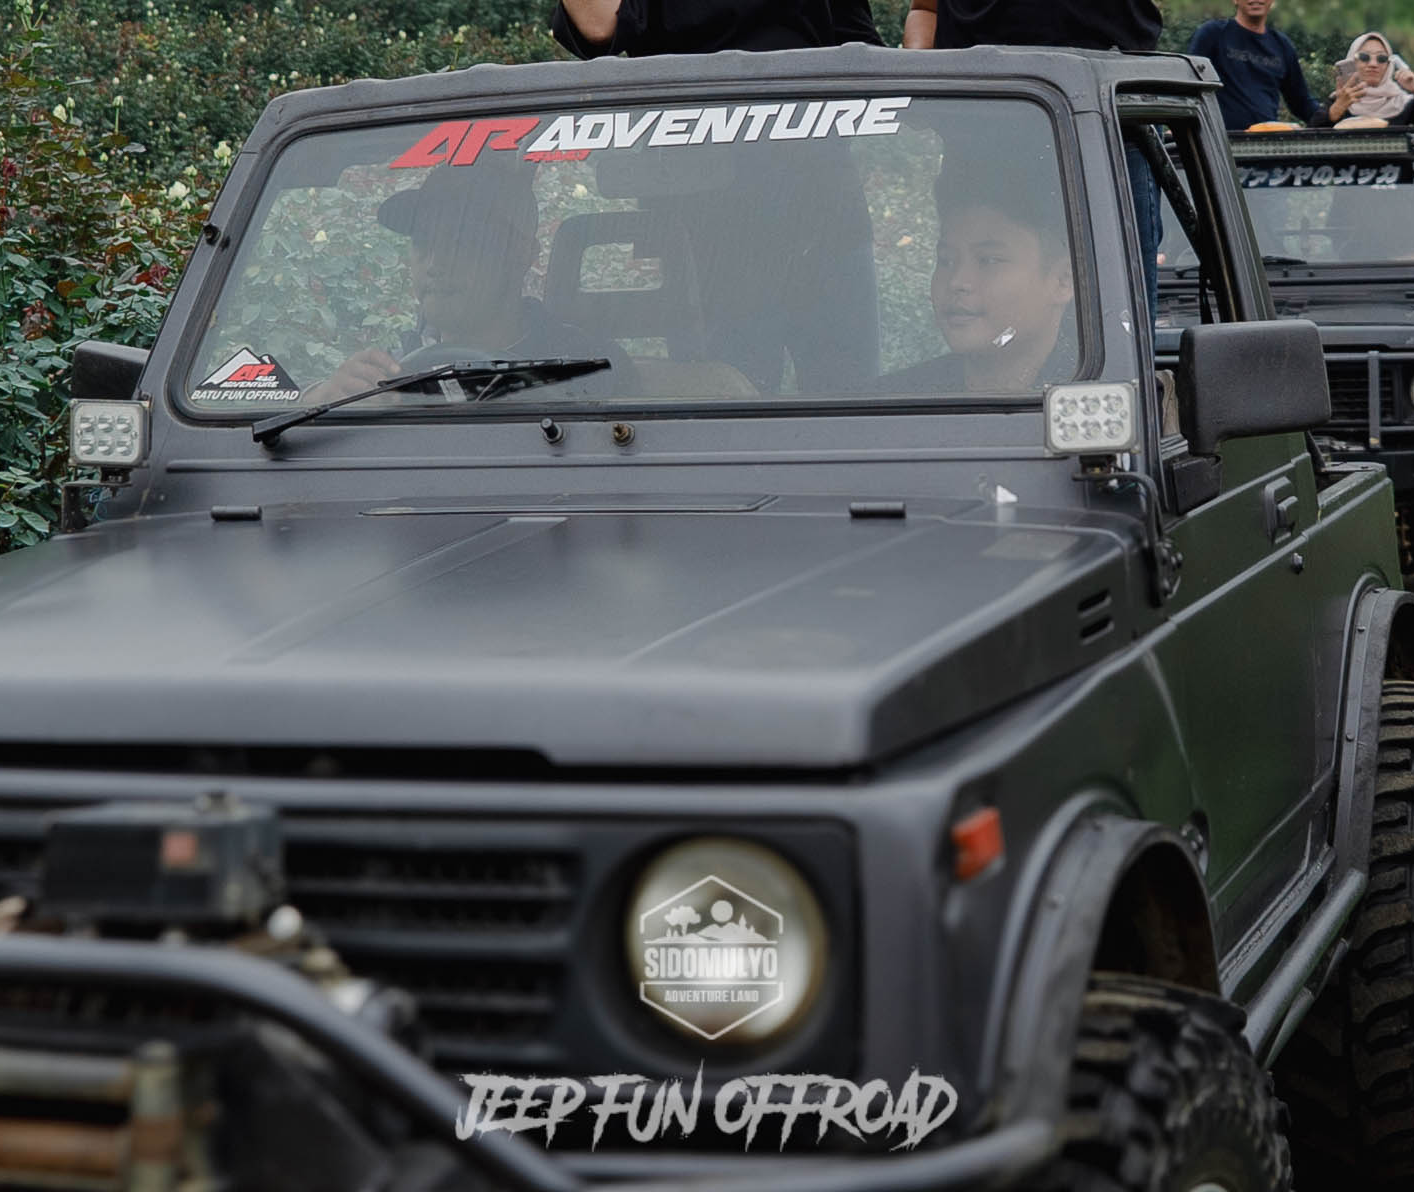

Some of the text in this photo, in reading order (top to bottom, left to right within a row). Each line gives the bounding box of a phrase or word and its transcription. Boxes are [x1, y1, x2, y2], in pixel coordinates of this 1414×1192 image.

[526, 97, 912, 152] ADVENTURE
[191, 390, 300, 400] BATU FUN OFFROAD
